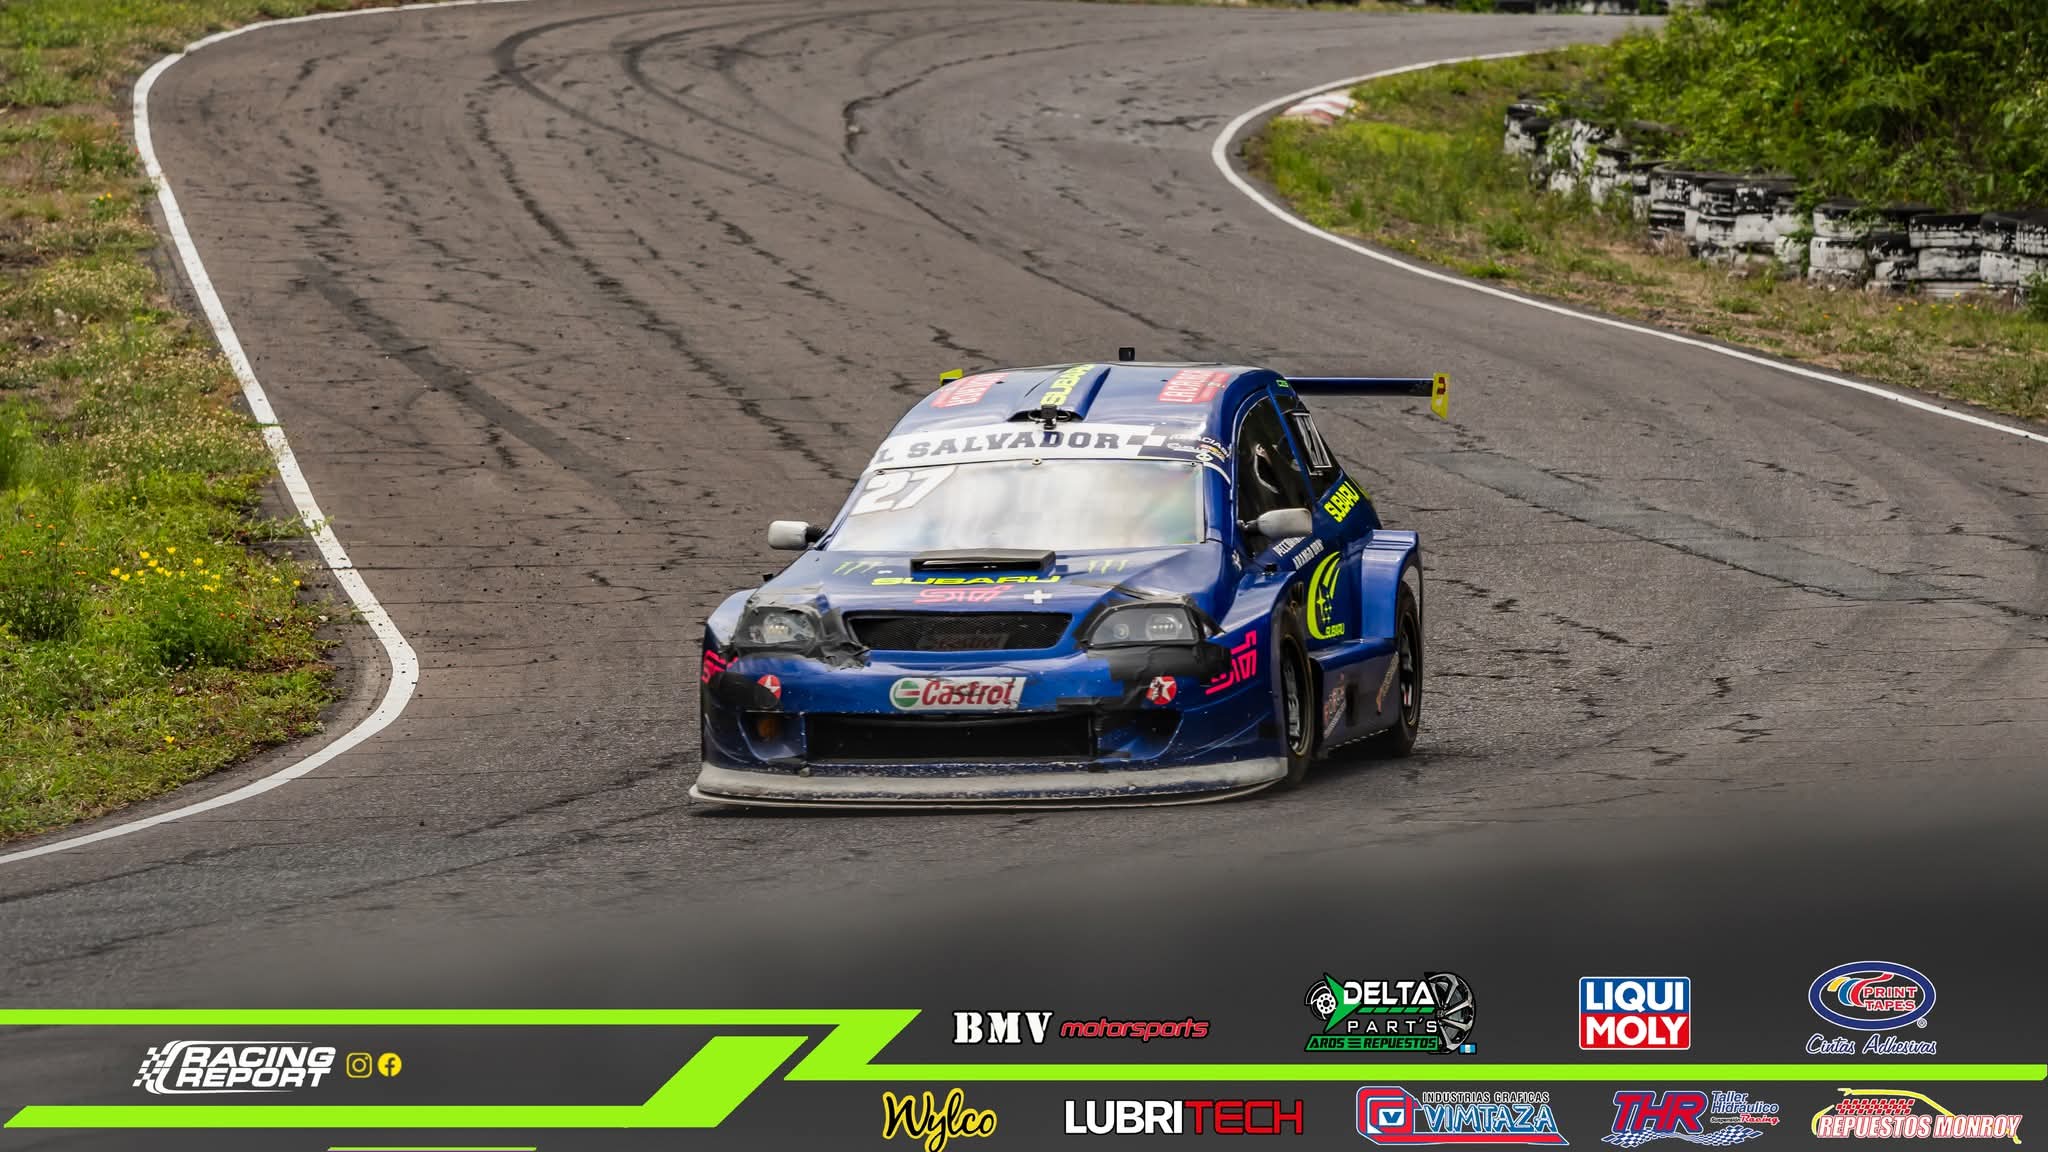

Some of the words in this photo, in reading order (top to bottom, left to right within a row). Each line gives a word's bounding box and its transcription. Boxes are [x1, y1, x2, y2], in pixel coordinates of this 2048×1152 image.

[908, 431, 1120, 459] SALVADOR
[851, 466, 958, 515] 27
[1323, 480, 1360, 523] SUBARU
[871, 575, 1061, 586] SUBARU
[922, 679, 1015, 706] Castrol
